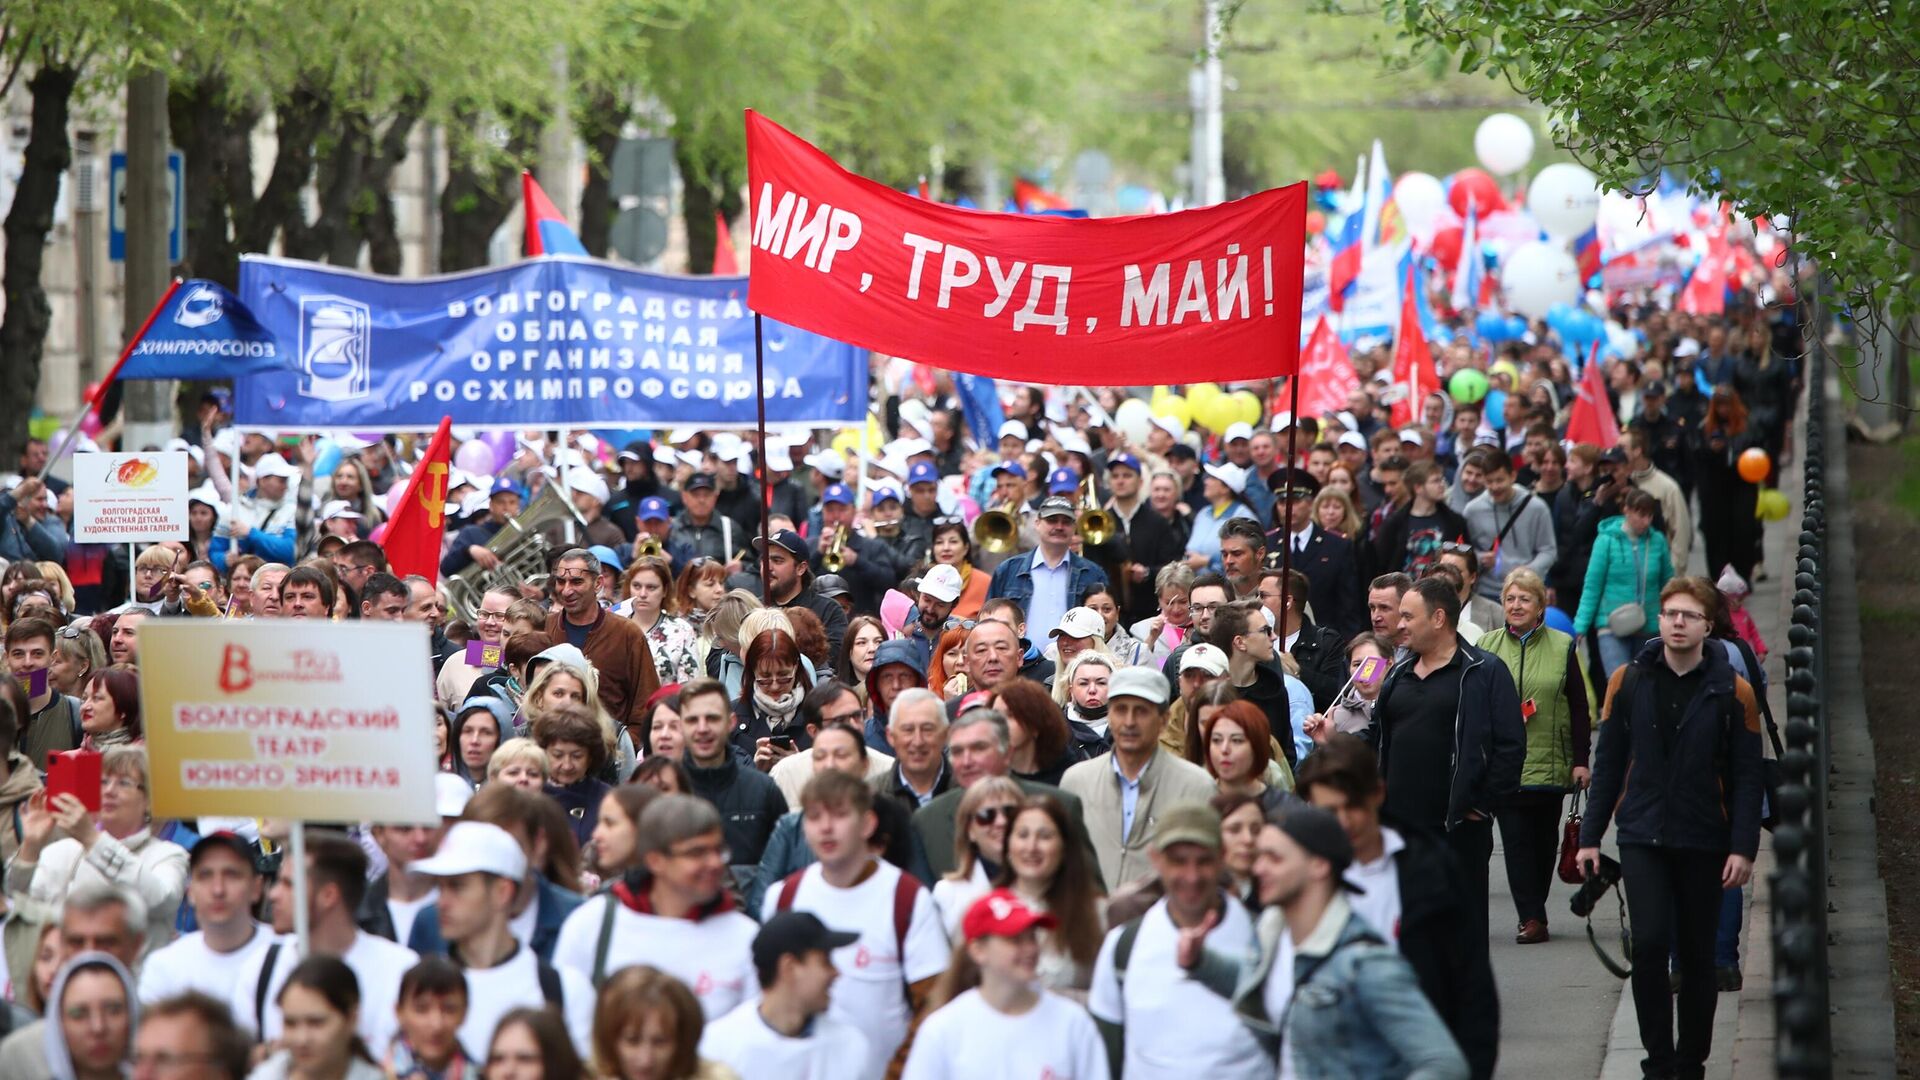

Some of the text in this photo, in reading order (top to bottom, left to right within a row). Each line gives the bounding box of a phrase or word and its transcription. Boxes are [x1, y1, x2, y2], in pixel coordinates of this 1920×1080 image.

[753, 182, 1274, 336] МИР, ТРУД, МАЙ!
[495, 319, 719, 348] ОБЛАСТНАЯ
[132, 339, 276, 358] ХИМПРОФСОЮЗ
[470, 347, 743, 375] ОРГАНИЗАЦИЯ
[94, 515, 168, 525] ОБЛАСТНАЯ ДЕТСКАЯ
[102, 506, 161, 515] ВОЛГОГРАДСКАЯ
[83, 524, 180, 534] ХУДОЖЕСТВЕННАЯ ГАЛЕРЕЯ
[178, 705, 400, 731] ВОЛГОГРАДСКИЙ
[256, 736, 328, 757] ТЕАТР
[184, 764, 401, 788] ЮНОГО ЗРИТЕЛЯ
